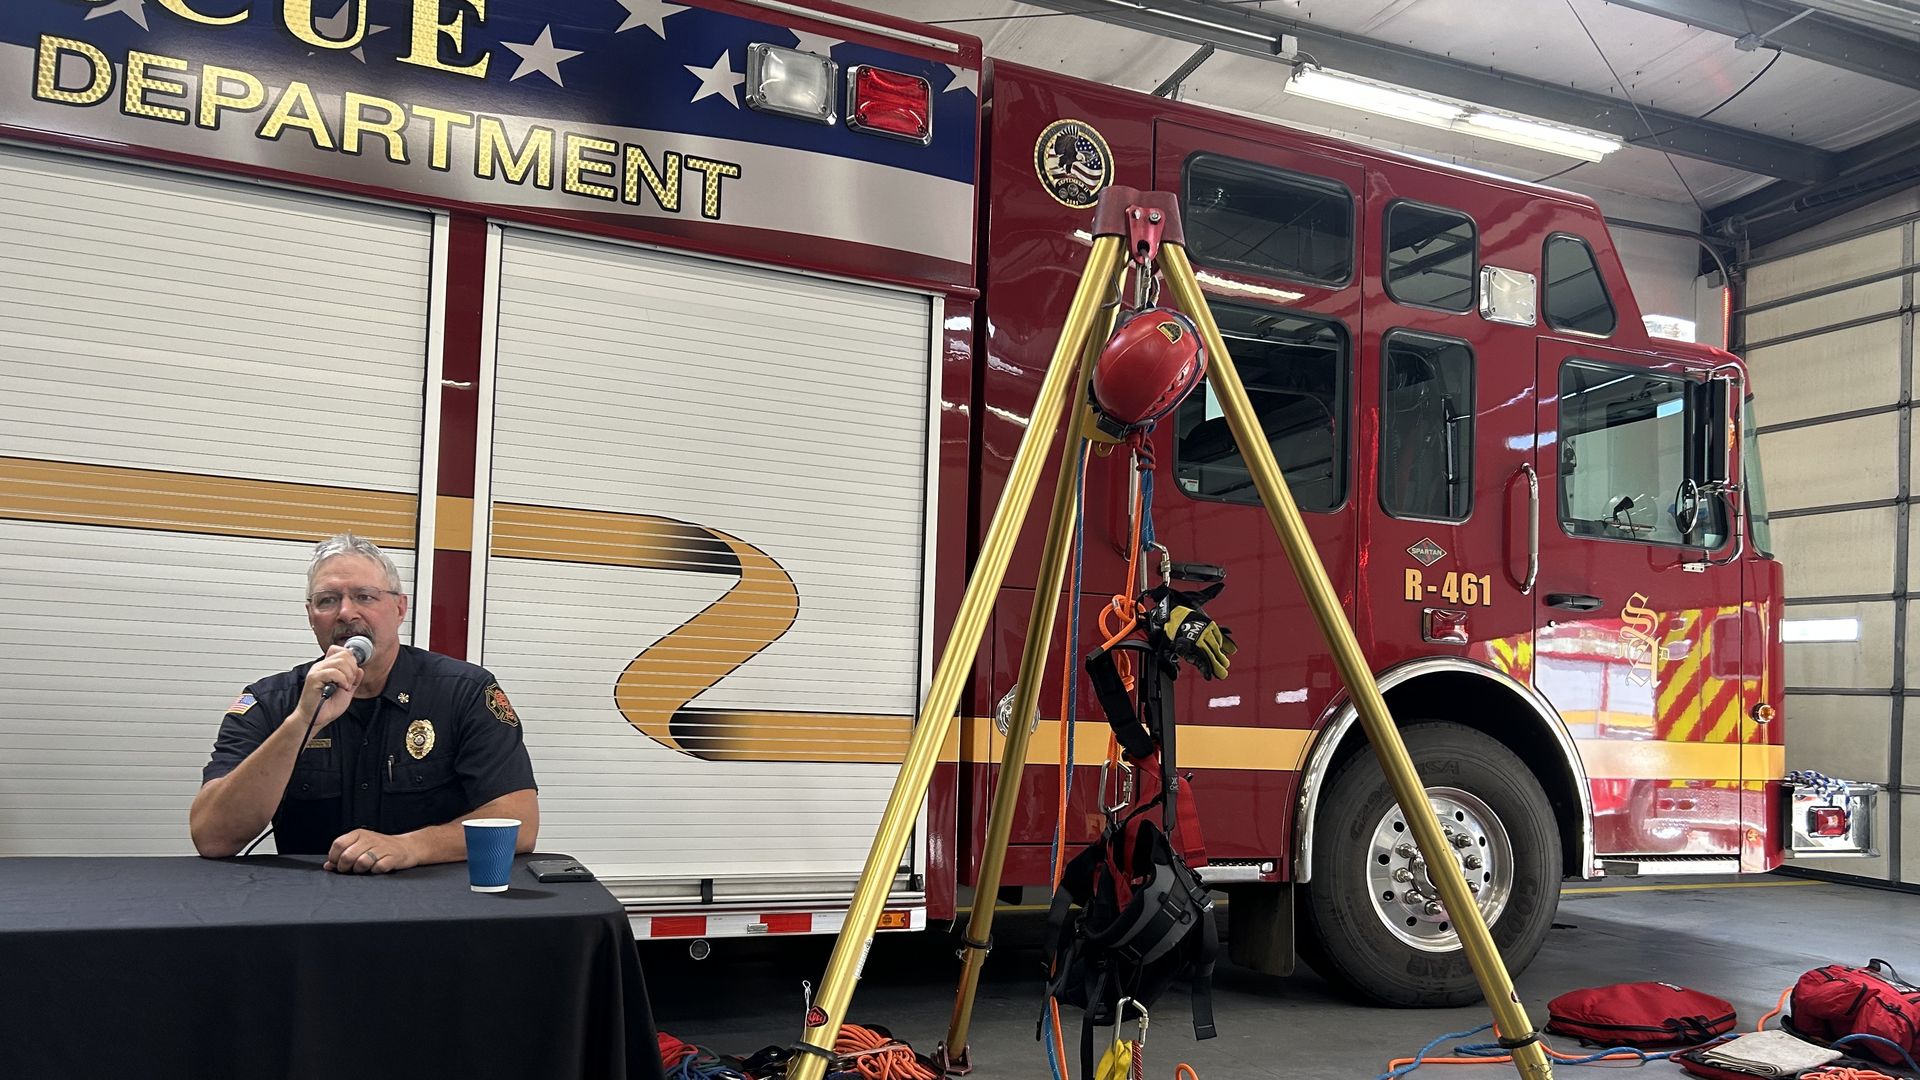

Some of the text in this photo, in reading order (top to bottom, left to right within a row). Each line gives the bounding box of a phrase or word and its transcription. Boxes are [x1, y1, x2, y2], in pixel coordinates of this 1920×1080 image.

[35, 33, 740, 220] DEPARTMENT
[1411, 547, 1443, 556] SPARTAN
[1186, 621, 1205, 641] PMI
